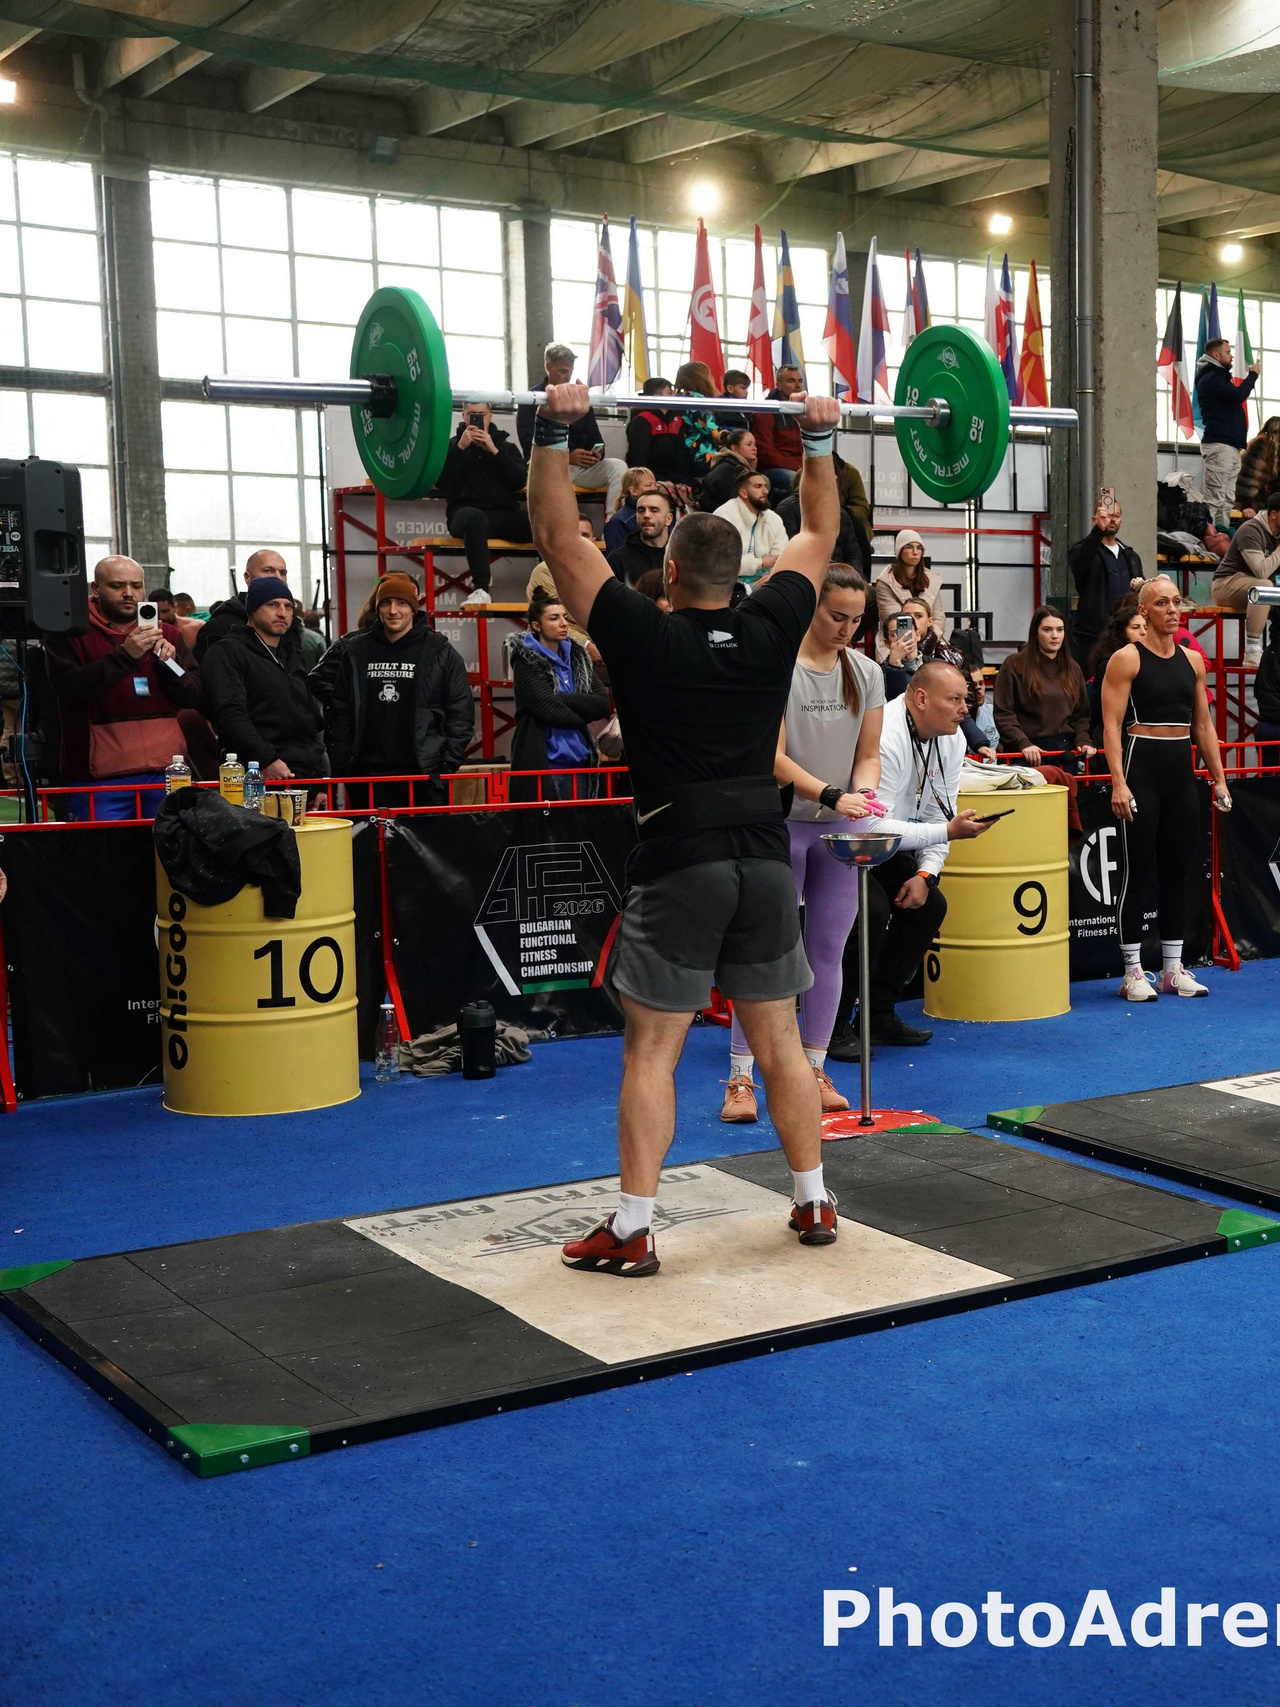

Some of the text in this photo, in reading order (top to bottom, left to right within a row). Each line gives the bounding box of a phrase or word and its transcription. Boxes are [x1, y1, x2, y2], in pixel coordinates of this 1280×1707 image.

[406, 348, 419, 364] KG
[409, 363, 421, 382] 10
[906, 385, 920, 401] 10
[363, 422, 374, 438] KG
[971, 415, 985, 430] KG
[375, 402, 421, 470] METAL ART
[969, 429, 984, 445] 10
[909, 428, 970, 478] METAL ART
[367, 662, 416, 671] BUILT BY
[367, 670, 415, 679] PRESSURE
[553, 899, 605, 916] 2026
[1013, 880, 1048, 936] 9
[519, 919, 572, 934] BULGARIAN
[1077, 927, 1108, 938] Fitness
[520, 933, 577, 949] FUNCTIONAL
[520, 949, 557, 963] FITNESS
[253, 936, 344, 1010] 10
[521, 961, 594, 978] CHAMPIONSHIP
[380, 1203, 496, 1232] ART
